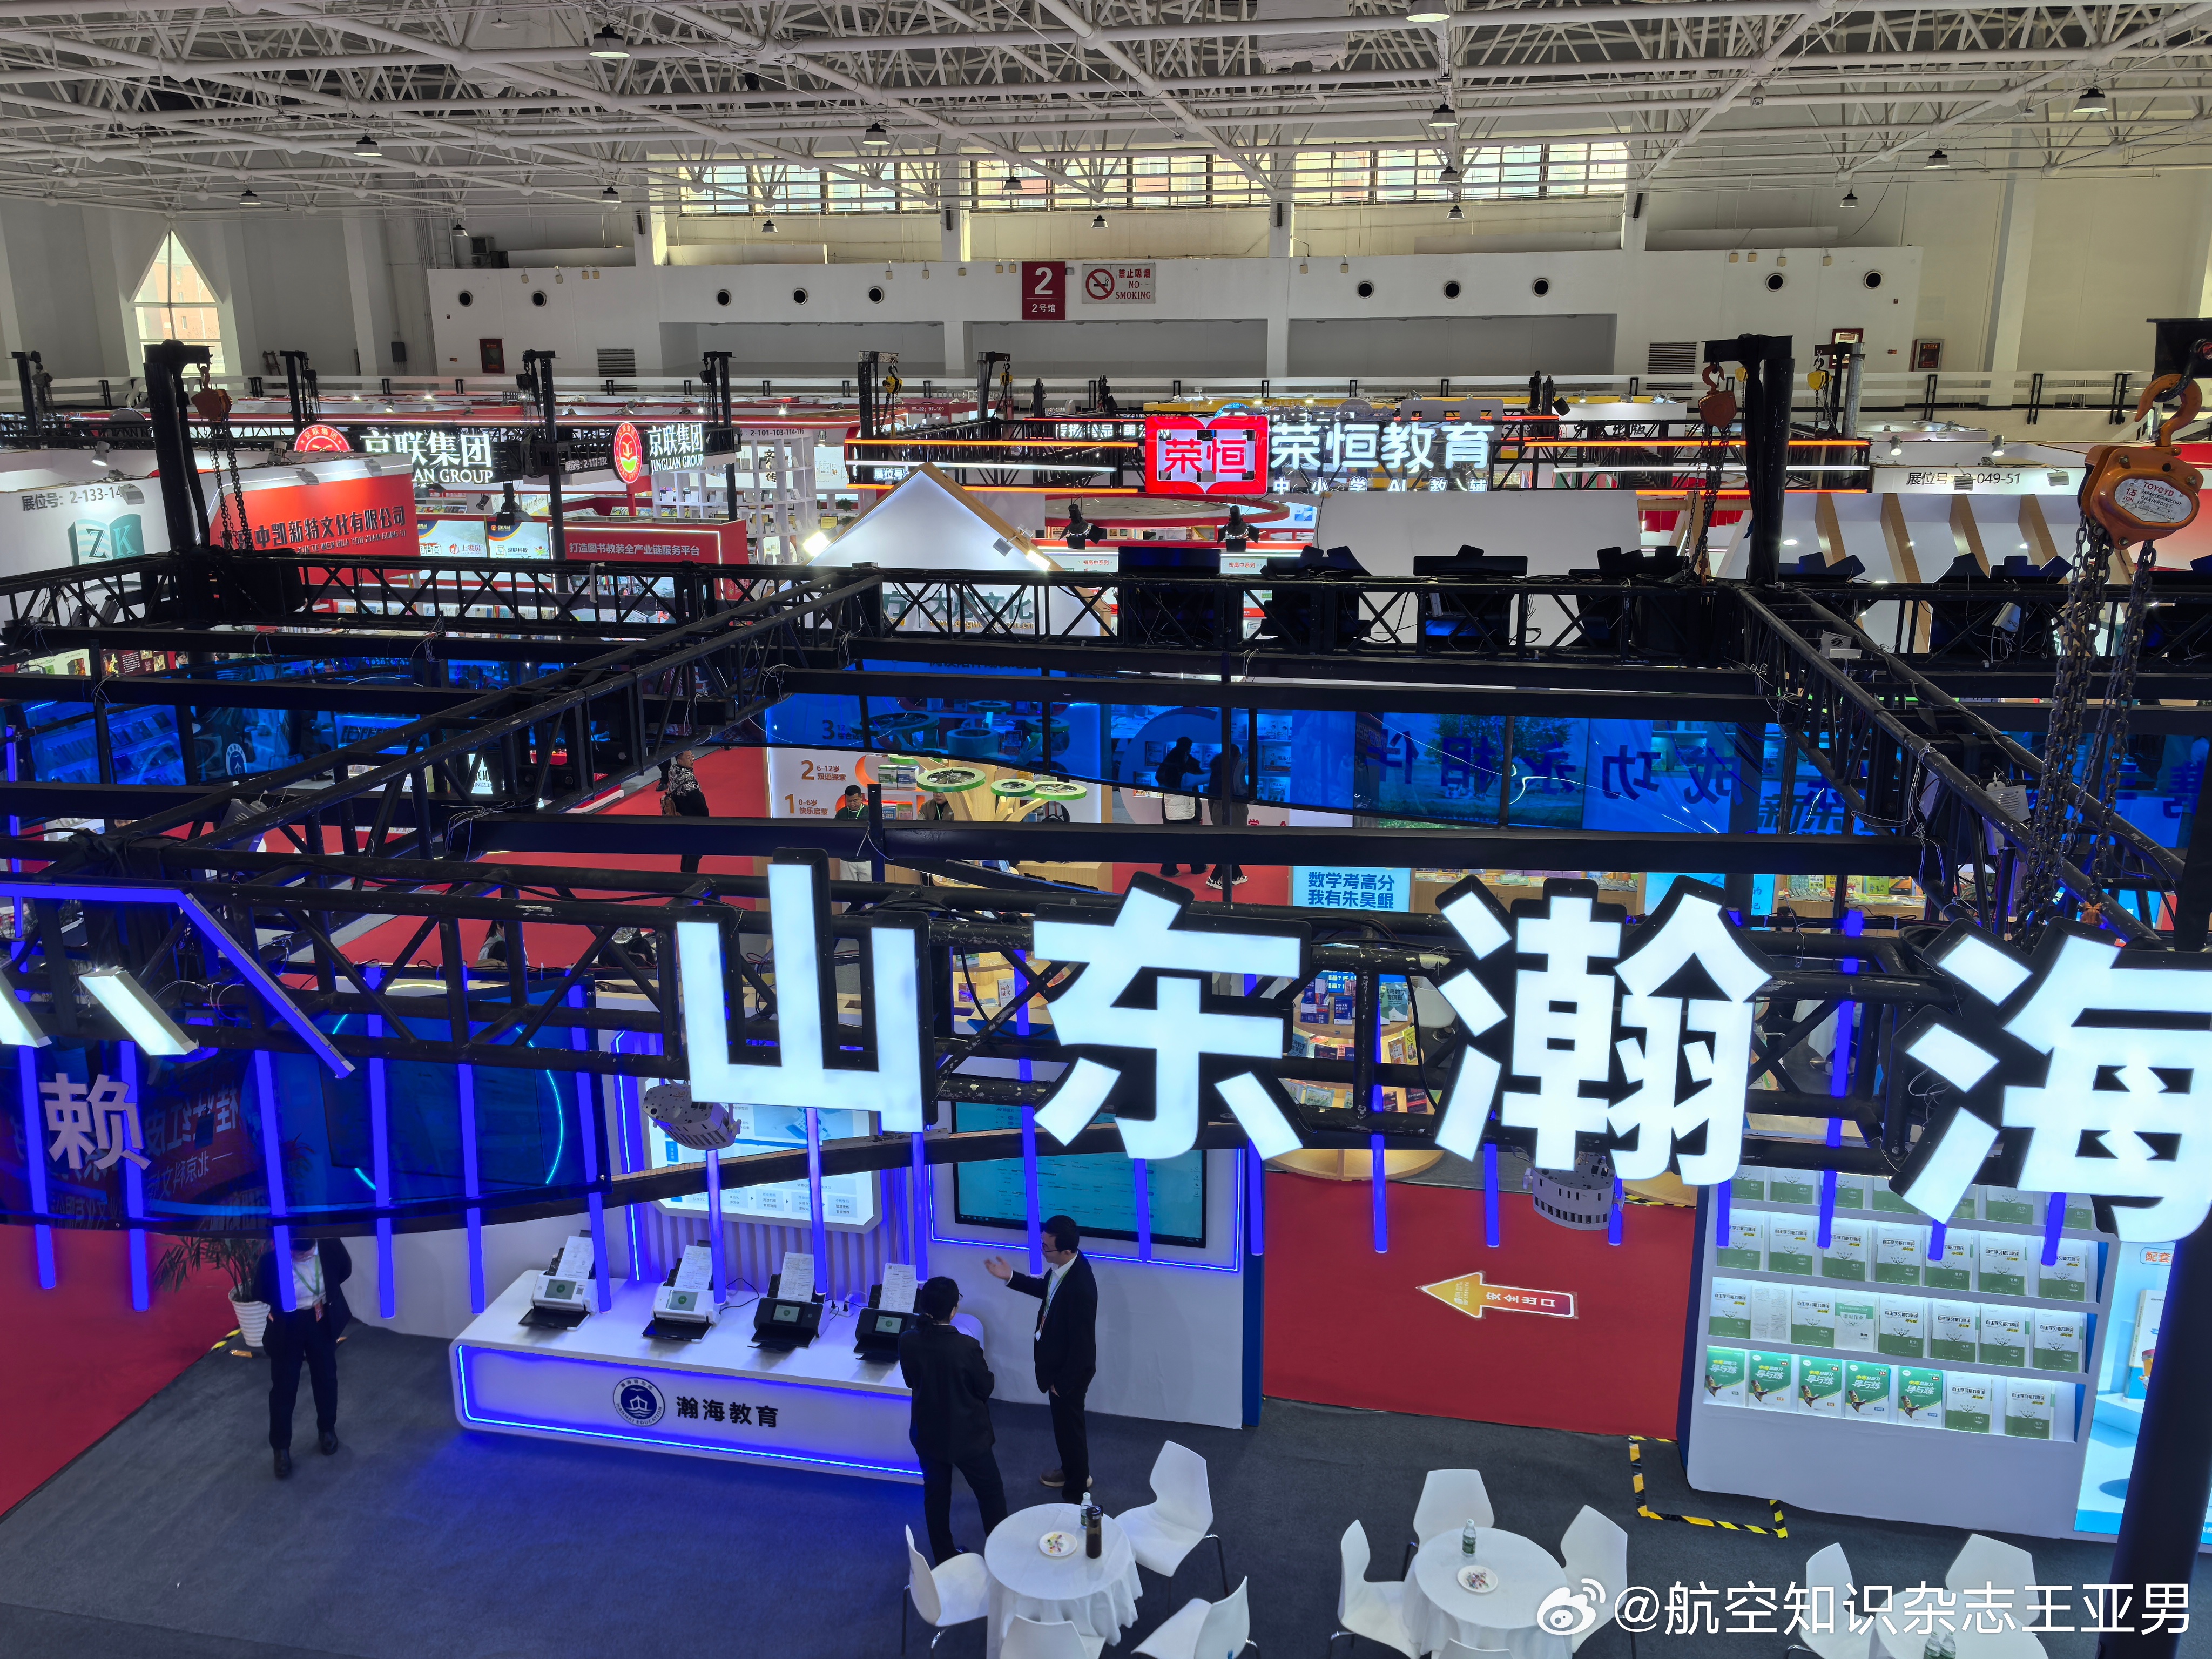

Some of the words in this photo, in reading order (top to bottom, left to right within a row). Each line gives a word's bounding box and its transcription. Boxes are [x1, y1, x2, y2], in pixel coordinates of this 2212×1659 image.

[1034, 267, 1053, 294] 2
[1118, 268, 1151, 279] 禁止吸烟
[1128, 280, 1140, 288] NO
[1115, 291, 1151, 300] SMOKING
[1031, 303, 1056, 313] 2号馆
[304, 427, 338, 441] 京联集团
[648, 422, 704, 457] 京联集团
[360, 430, 492, 468] 京联集团
[1271, 421, 1495, 470] 荣恒教育
[650, 456, 682, 475] JINGLIAN
[682, 454, 705, 468] GROUP
[1164, 437, 1248, 475] 荣恒
[439, 469, 494, 484] GROUP
[220, 505, 406, 553] 中凯新特文化有限公司
[569, 542, 700, 556] 打造图书教装全产业链服务平台
[801, 759, 814, 780] 2
[817, 773, 846, 781] 双语探索
[784, 794, 795, 814] 1
[799, 807, 828, 816] 快乐启蒙
[1308, 872, 1395, 892] 数学考高分
[1307, 889, 1394, 909] 我有朱昊鲲
[39, 1072, 151, 1171] 赖
[1485, 1292, 1556, 1307] 安全出口
[676, 1395, 779, 1428] 瀚海教育
